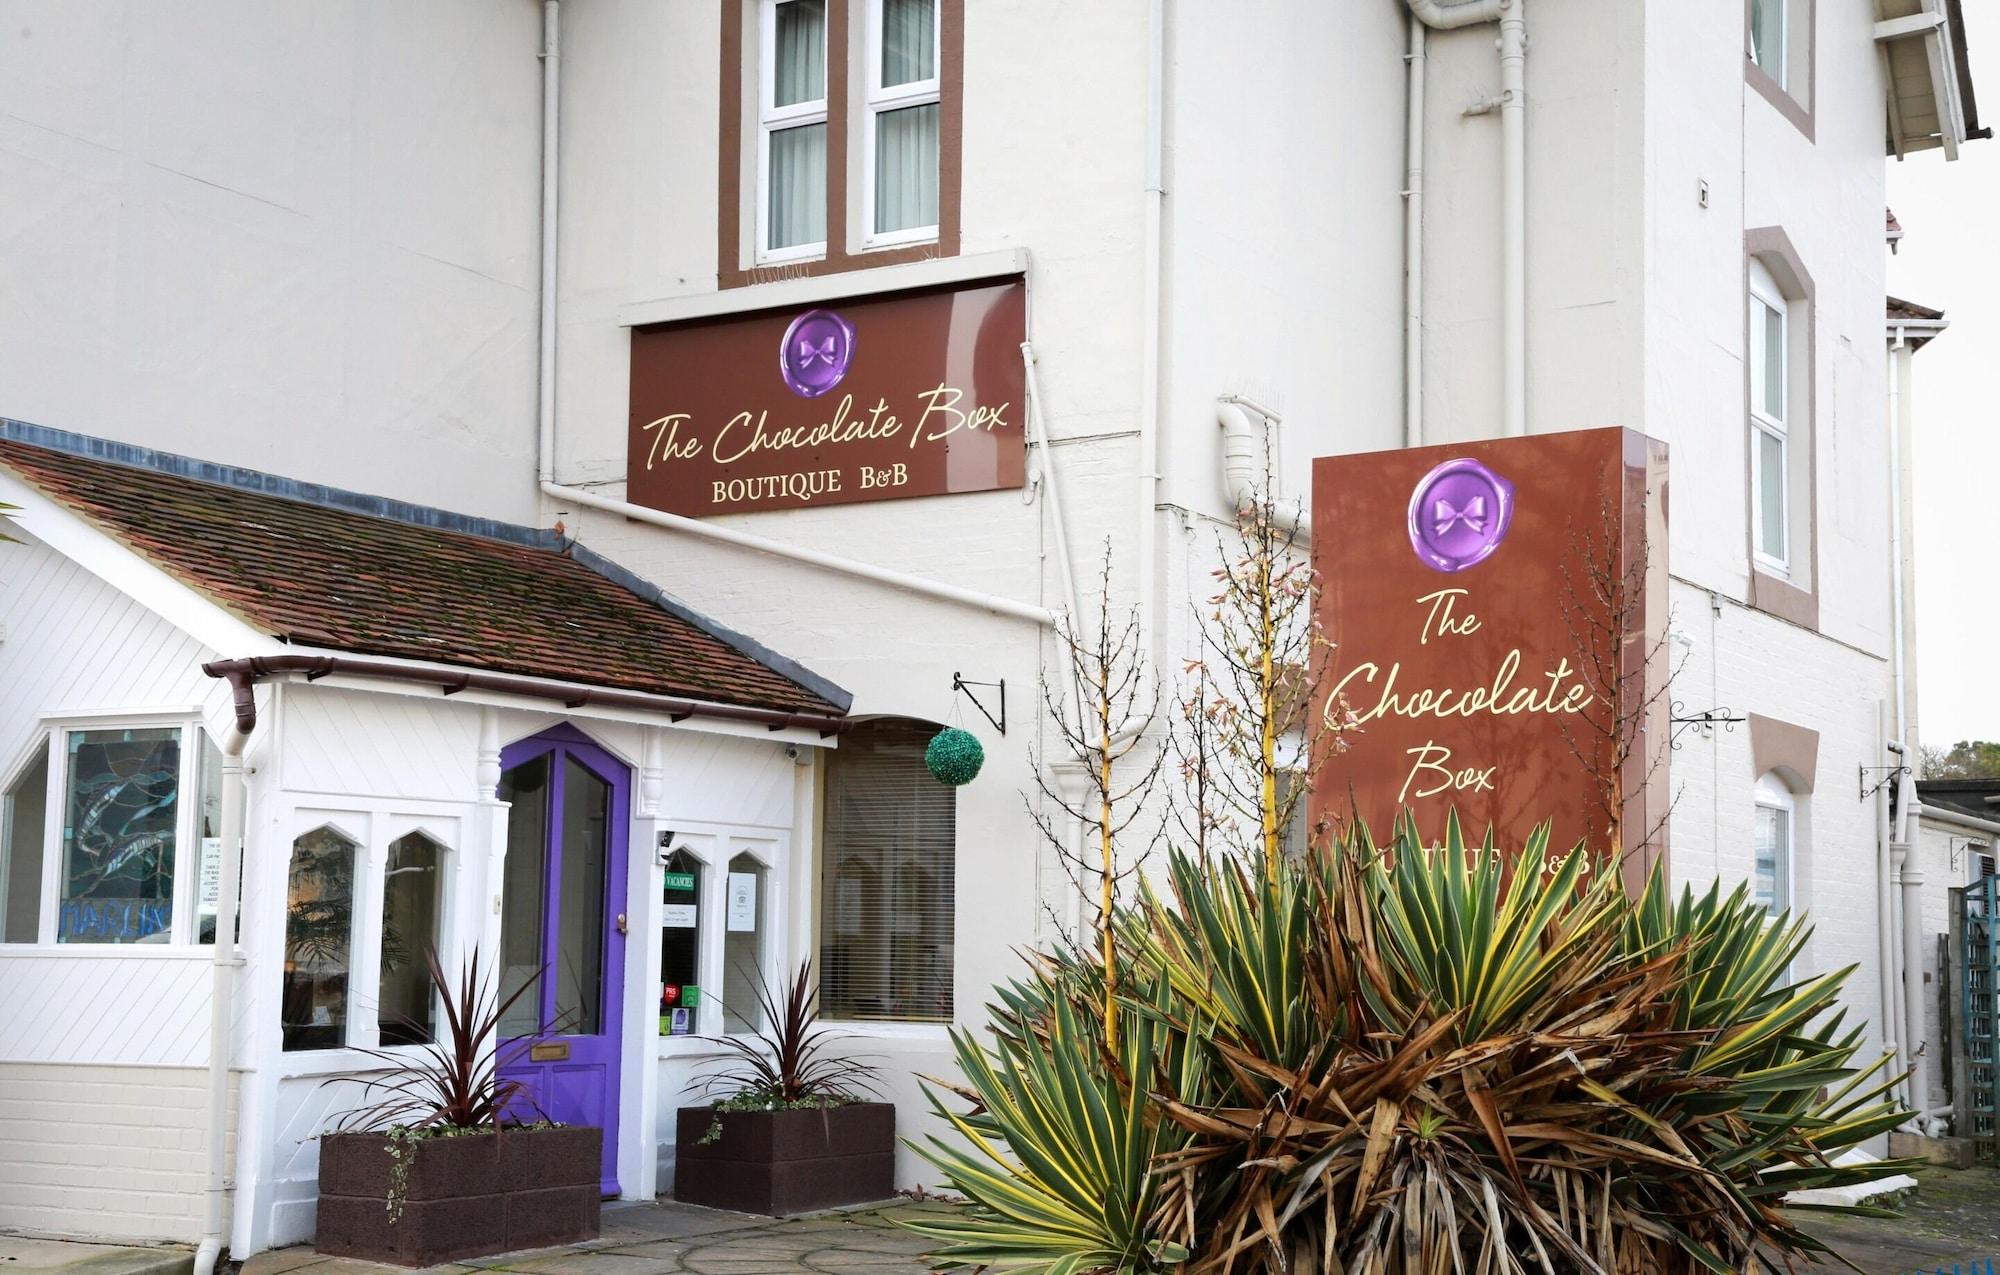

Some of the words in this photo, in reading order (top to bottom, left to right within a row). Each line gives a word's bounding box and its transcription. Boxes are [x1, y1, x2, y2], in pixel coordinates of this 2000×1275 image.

[642, 413, 702, 471] The
[712, 393, 902, 464] Chocolate
[909, 382, 1010, 449] Box
[711, 469, 842, 504] BOUTIQUE
[860, 463, 908, 489] B&B
[1415, 588, 1482, 645] The
[1323, 648, 1594, 731] Chocolate
[1398, 739, 1497, 804] Box
[666, 875, 693, 888] VACANCIES
